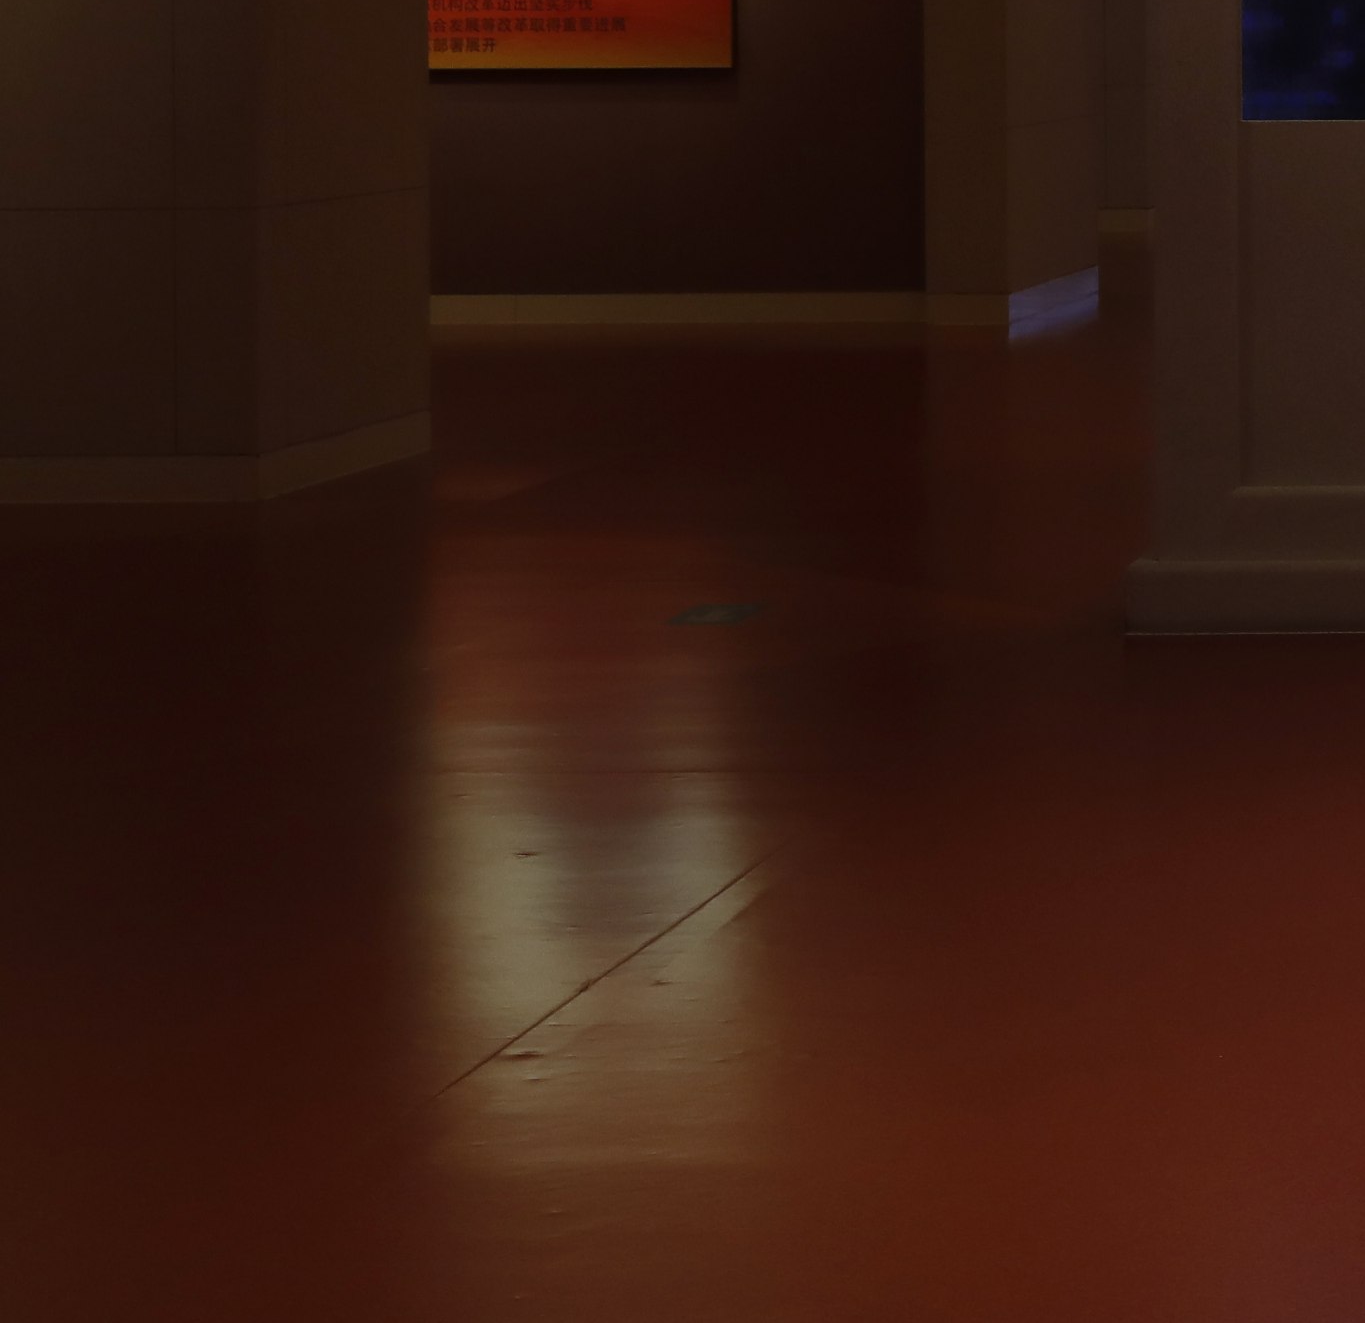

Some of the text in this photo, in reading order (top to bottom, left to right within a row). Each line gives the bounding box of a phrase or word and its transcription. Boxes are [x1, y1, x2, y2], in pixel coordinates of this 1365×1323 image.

[428, 15, 626, 33] 合发展等改革取得重要进展
[428, 37, 497, 53] 部署展开
